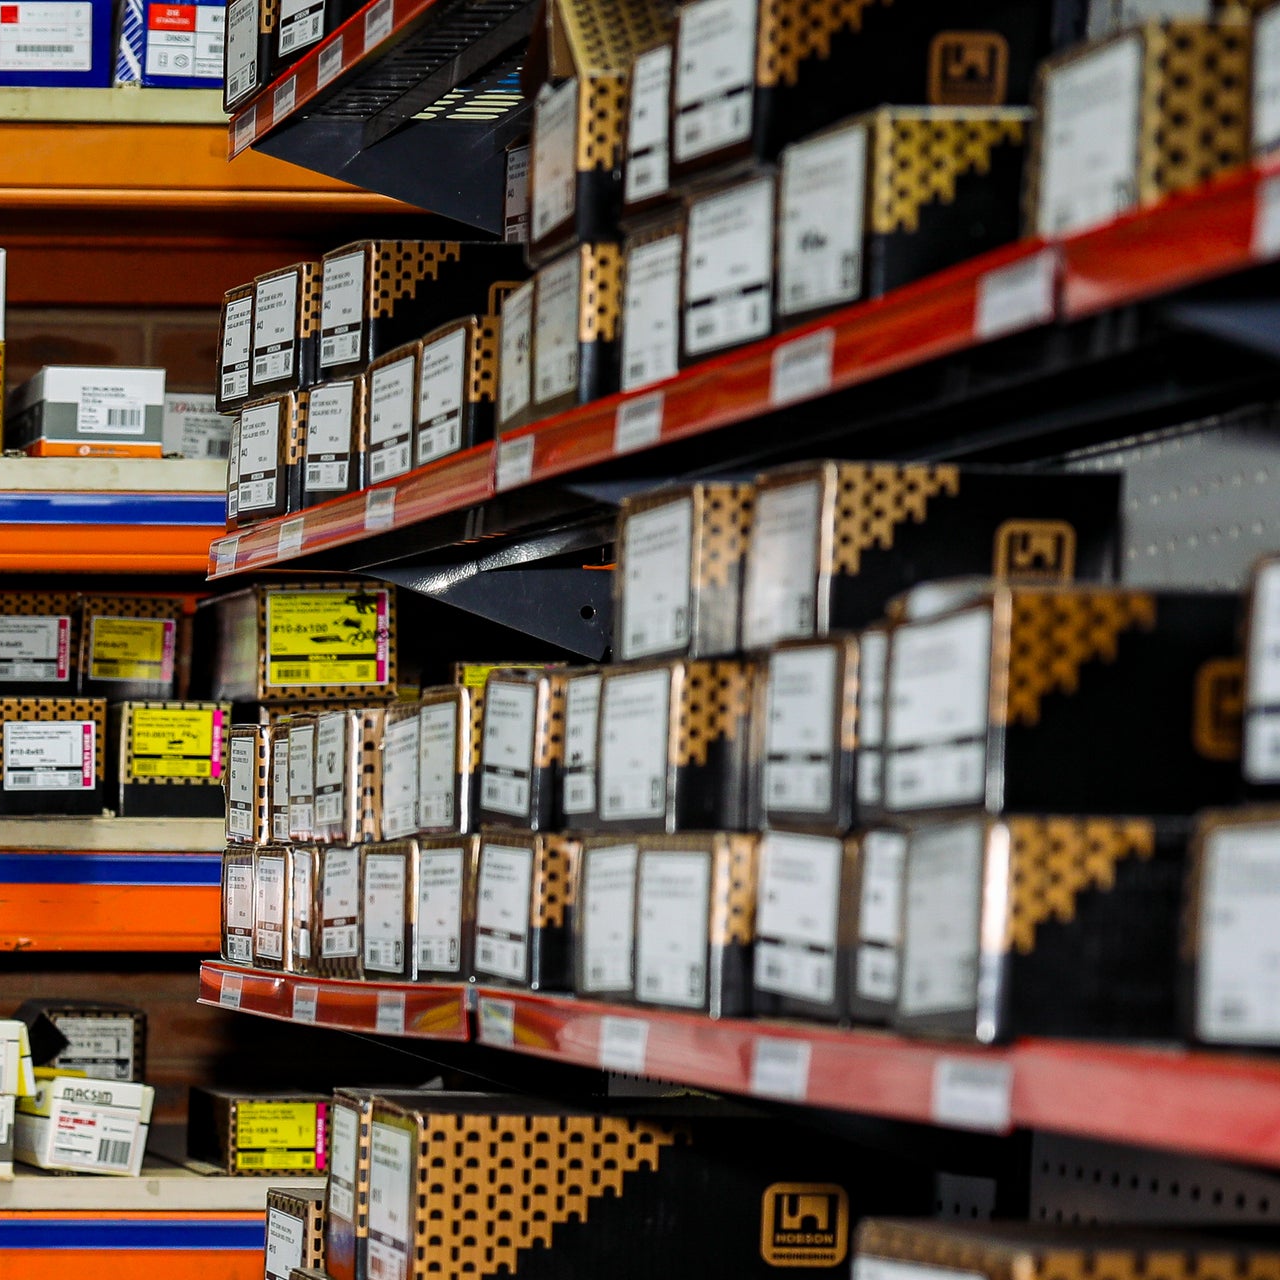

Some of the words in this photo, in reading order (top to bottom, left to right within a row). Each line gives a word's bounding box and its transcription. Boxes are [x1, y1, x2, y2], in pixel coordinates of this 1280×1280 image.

[63, 1087, 113, 1105] MACSIM
[775, 1232, 835, 1246] HOBSON
[771, 1252, 836, 1262] ENGINEERING
